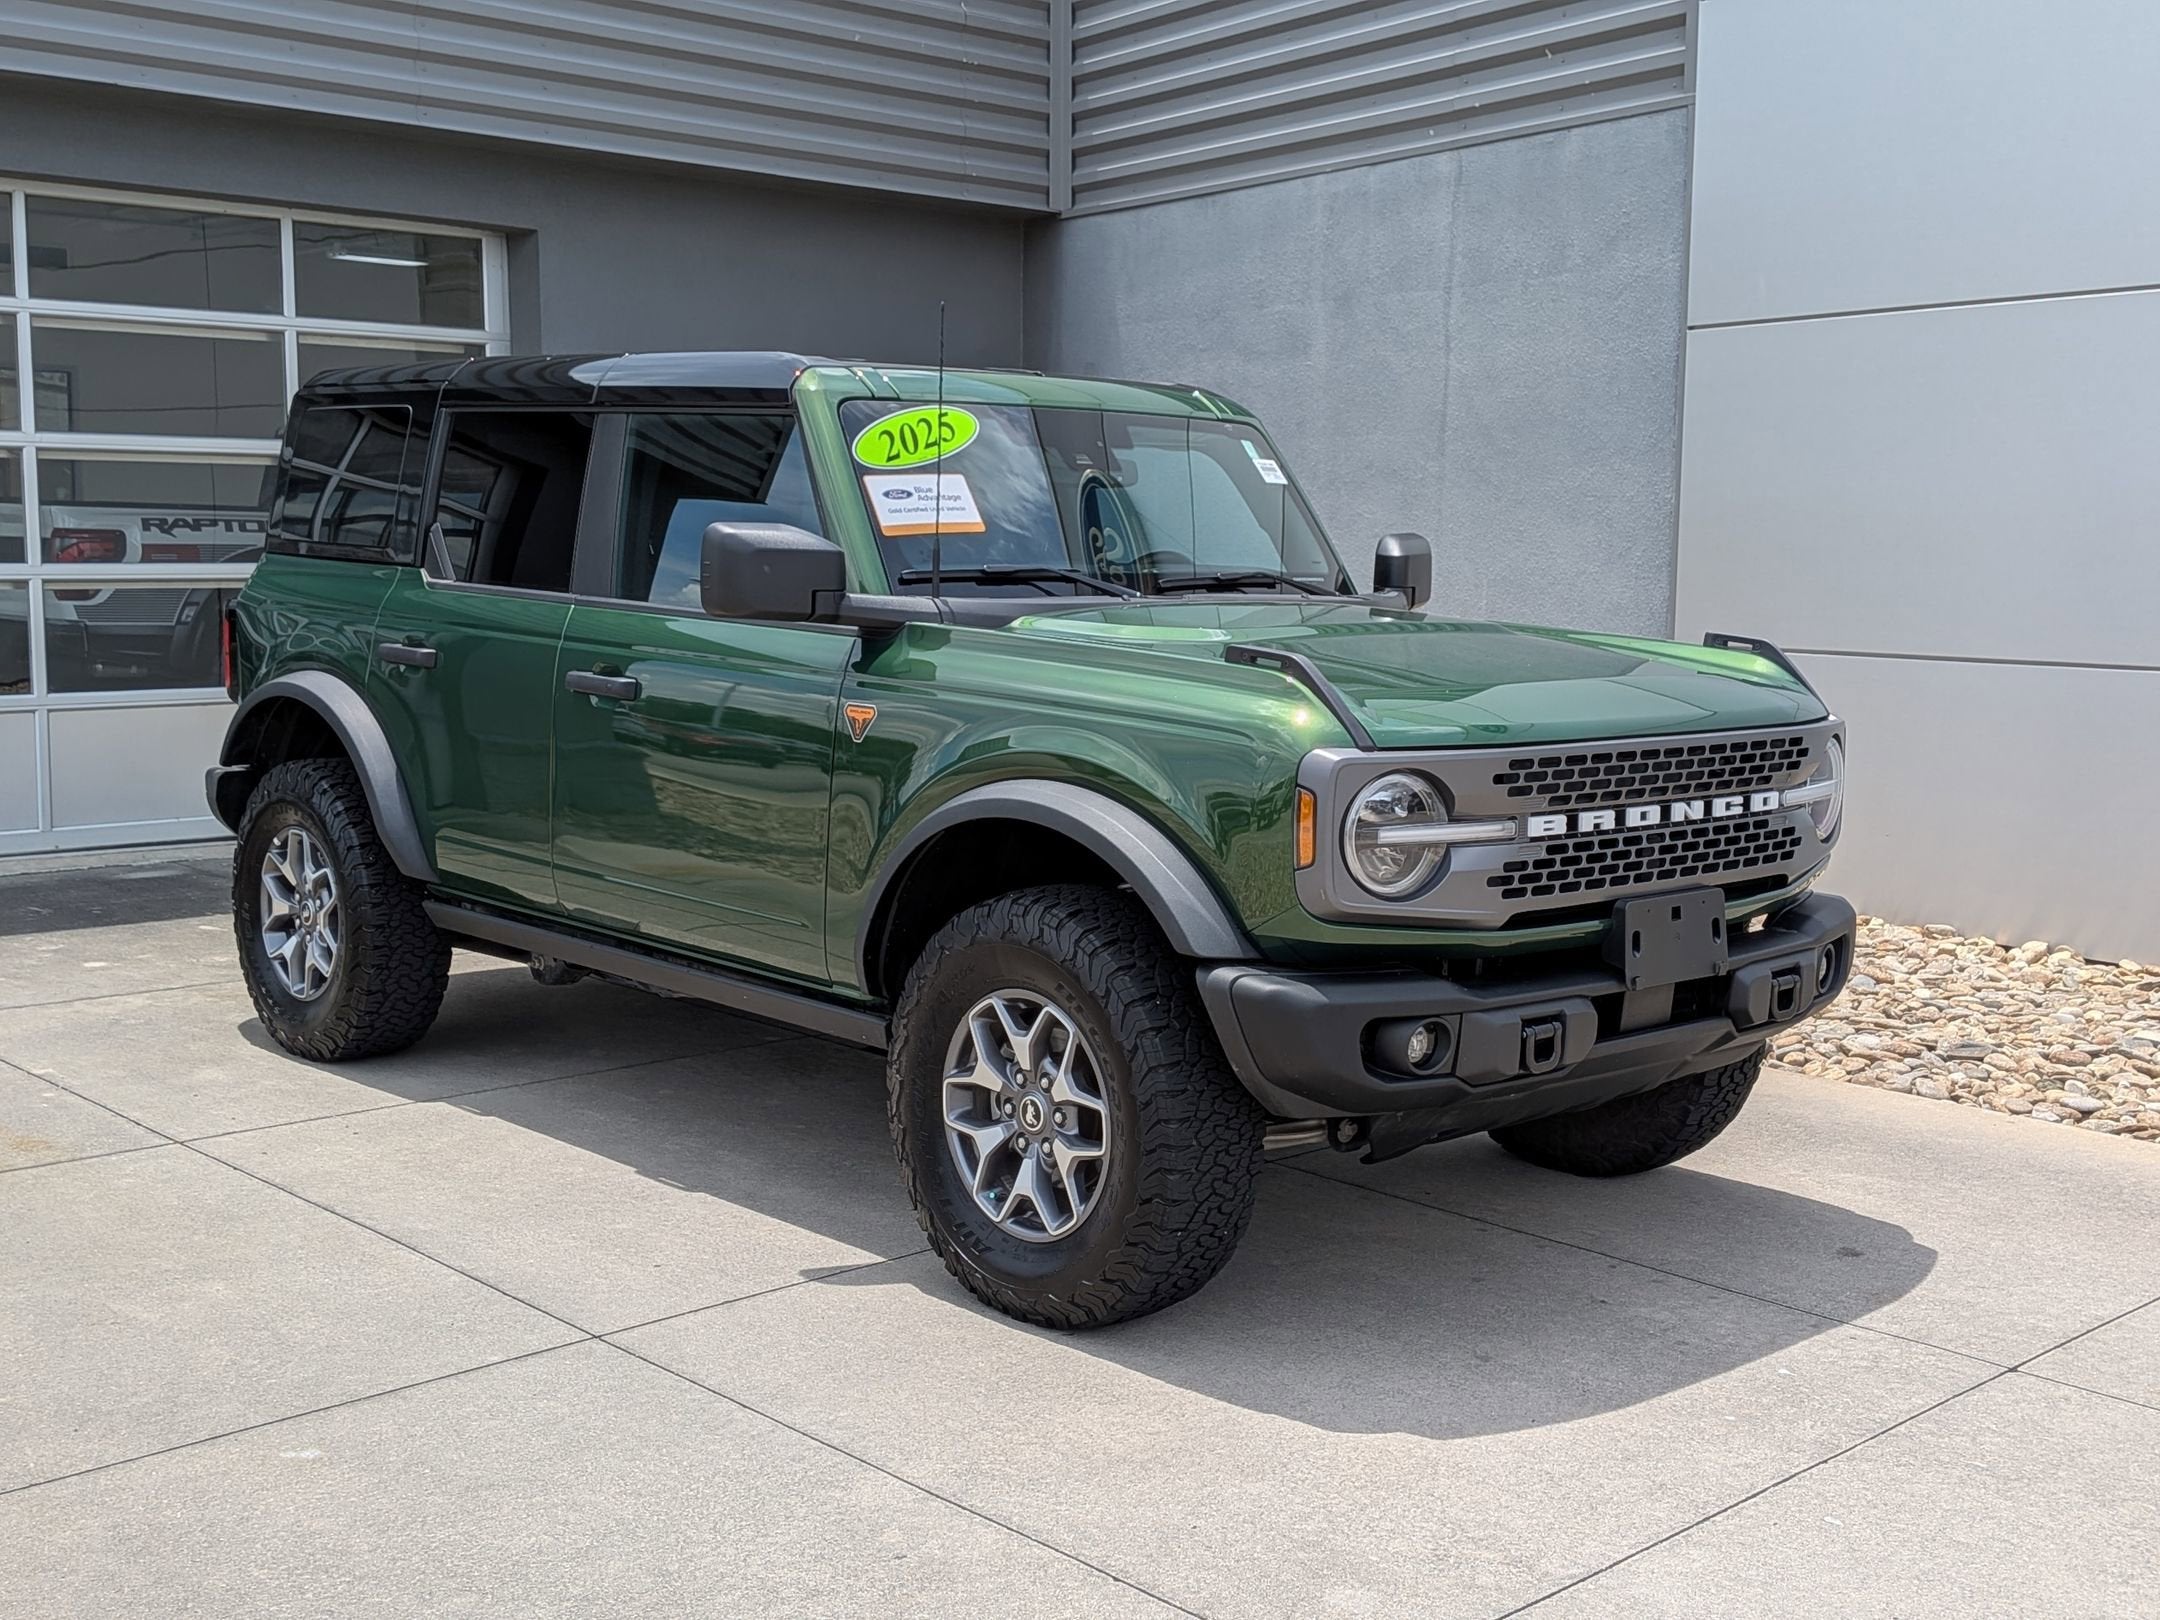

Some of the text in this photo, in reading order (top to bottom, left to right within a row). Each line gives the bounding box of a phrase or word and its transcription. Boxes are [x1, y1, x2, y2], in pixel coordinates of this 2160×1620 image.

[878, 412, 956, 463] 2025
[914, 486, 934, 494] Blue
[140, 516, 268, 538] RAPTO
[1527, 791, 1780, 838] BRONCO
